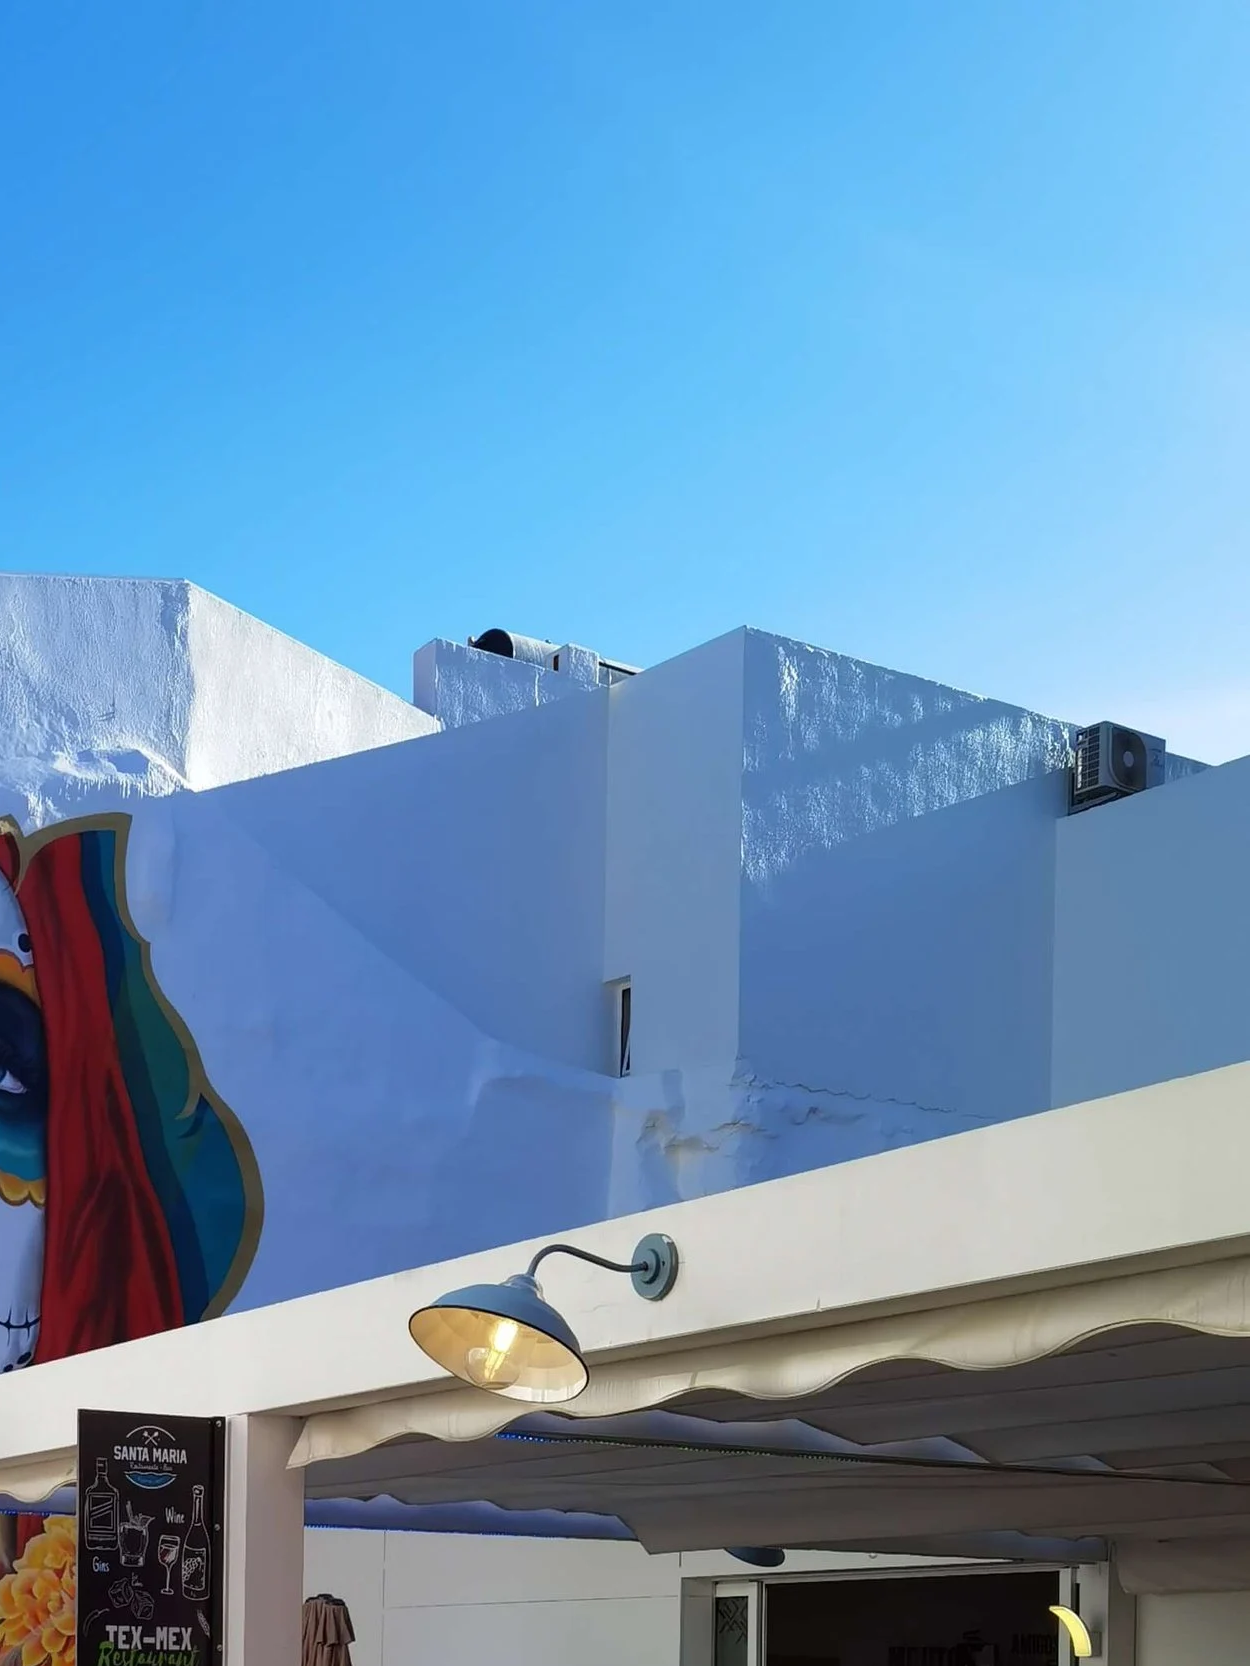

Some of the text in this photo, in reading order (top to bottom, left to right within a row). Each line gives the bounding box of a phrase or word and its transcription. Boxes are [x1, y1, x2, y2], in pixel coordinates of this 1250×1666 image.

[113, 1445, 187, 1464] SANTA MARIA
[165, 1506, 185, 1524] Wine
[92, 1556, 110, 1573] Gins
[105, 1625, 192, 1651] TEX-MEX
